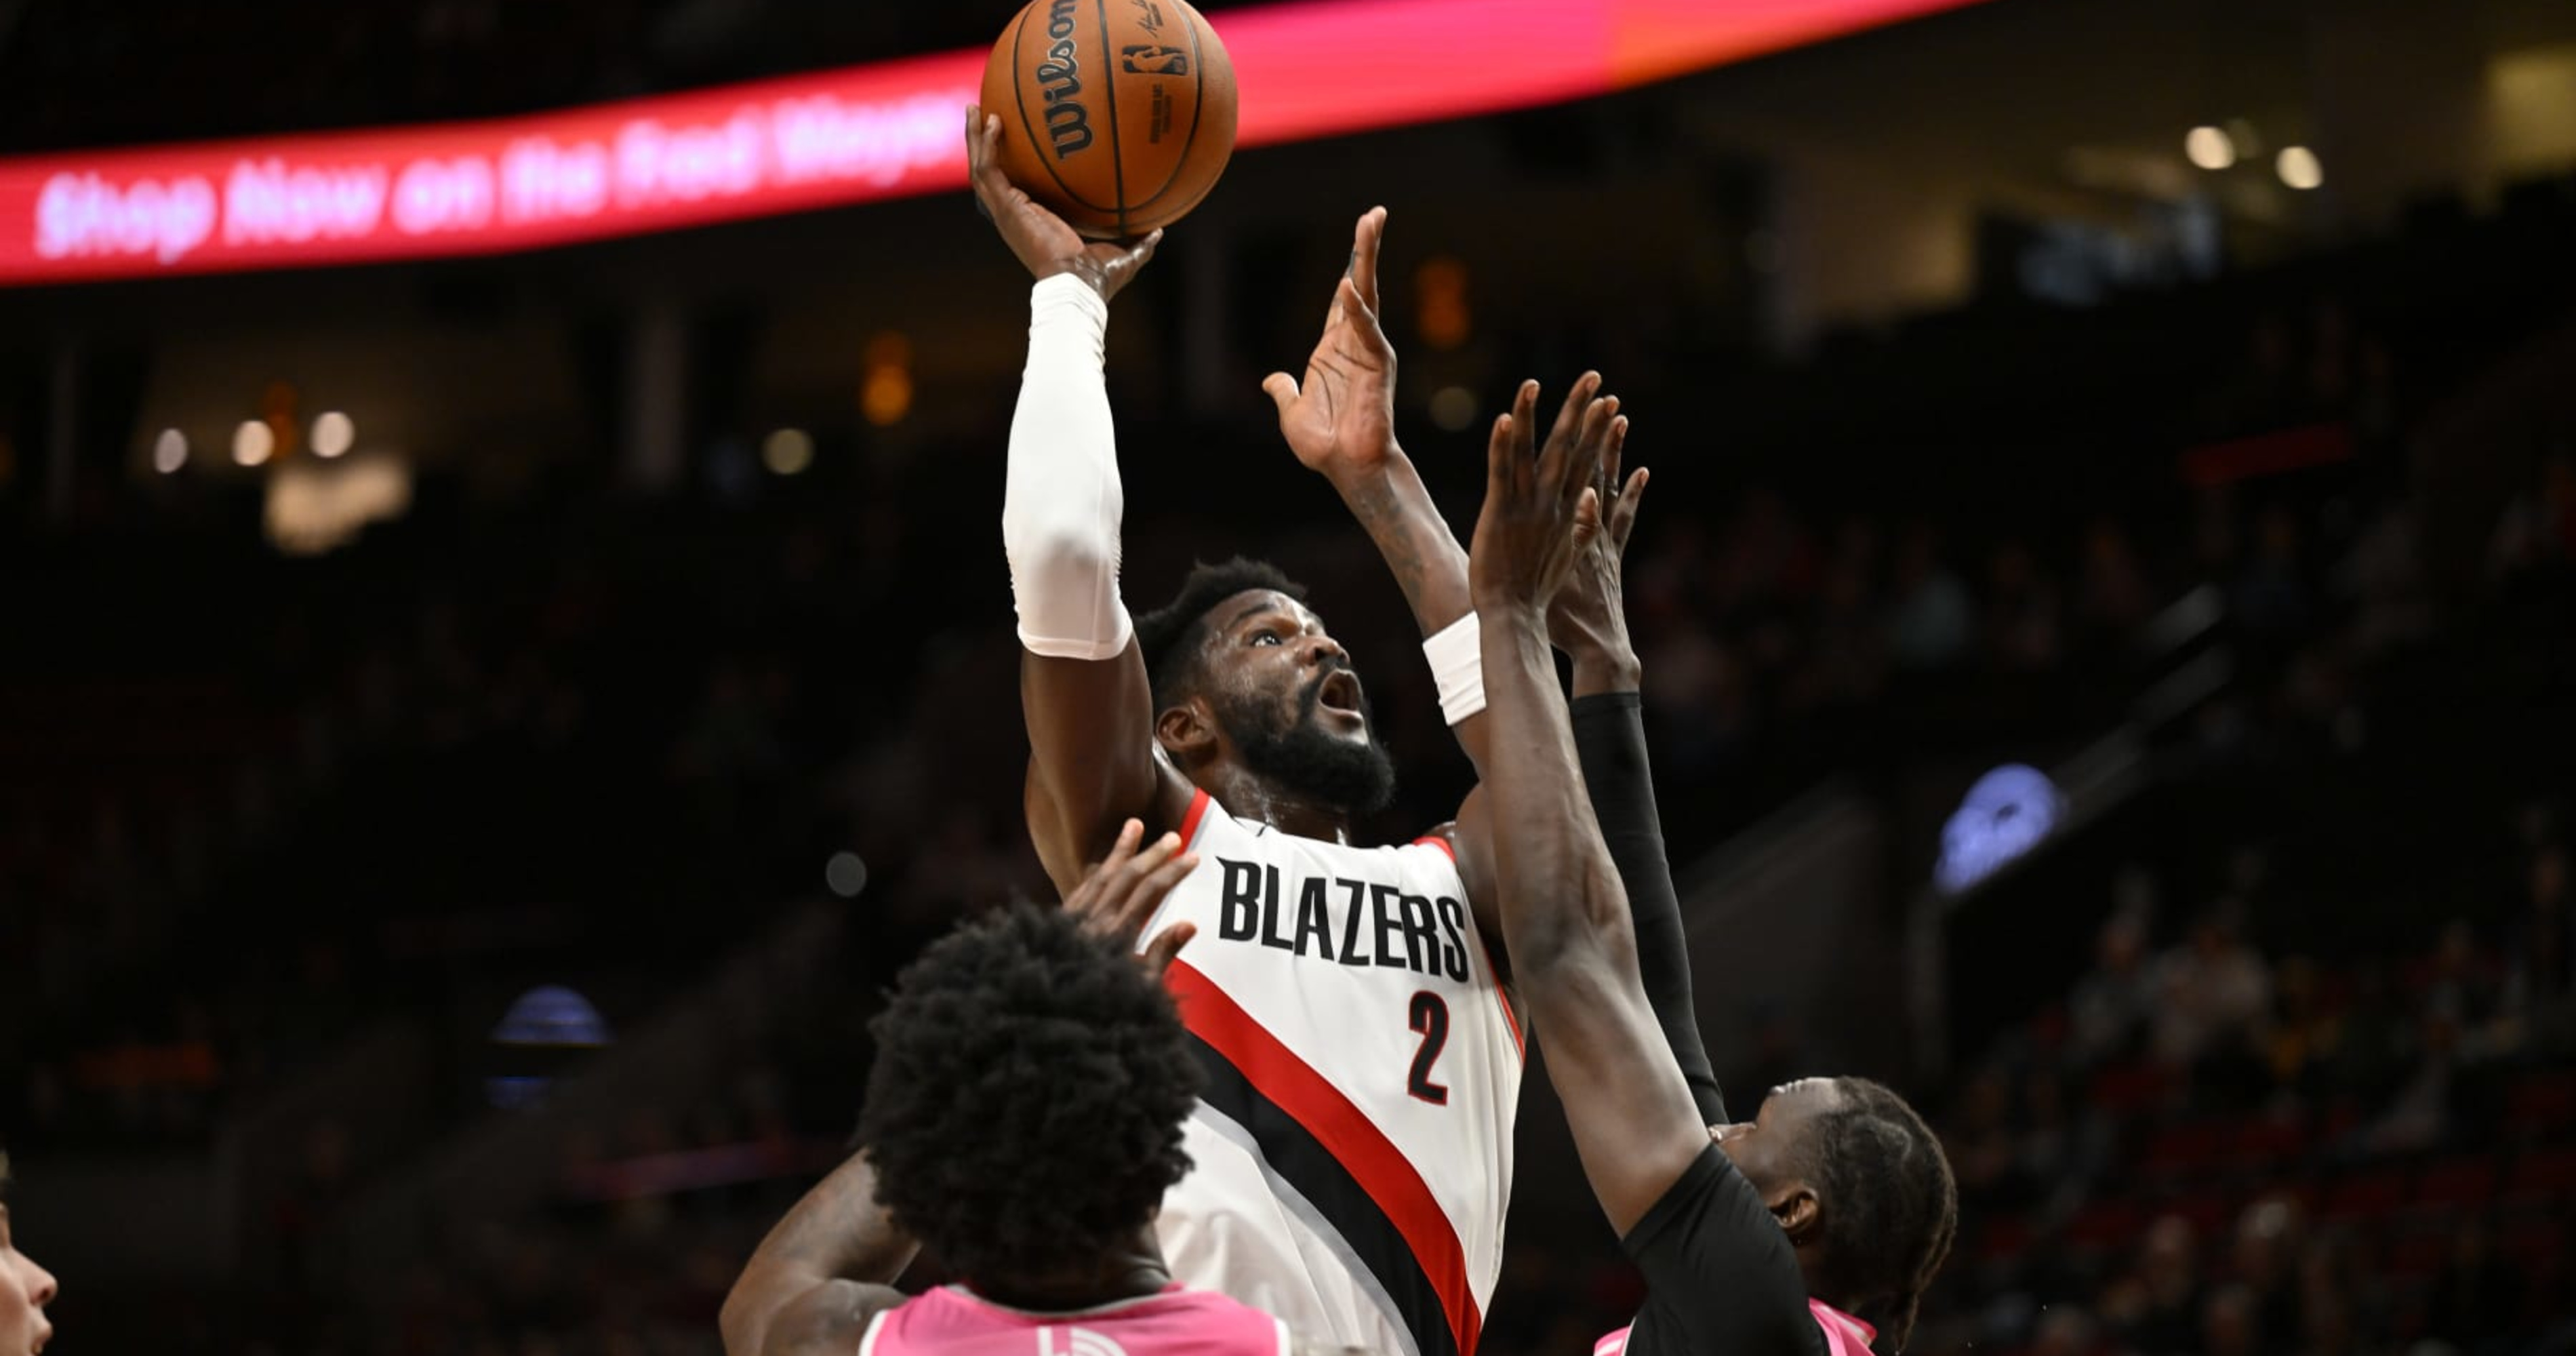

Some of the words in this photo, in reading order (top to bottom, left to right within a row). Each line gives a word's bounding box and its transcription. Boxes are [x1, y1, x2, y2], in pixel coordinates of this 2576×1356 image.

[35, 174, 217, 262] Shop
[224, 158, 387, 245] Now
[392, 158, 494, 235] on
[500, 134, 605, 225] the
[613, 108, 762, 207] Fred
[1215, 856, 1468, 982] BLAZERS
[1408, 990, 1449, 1106] 2
